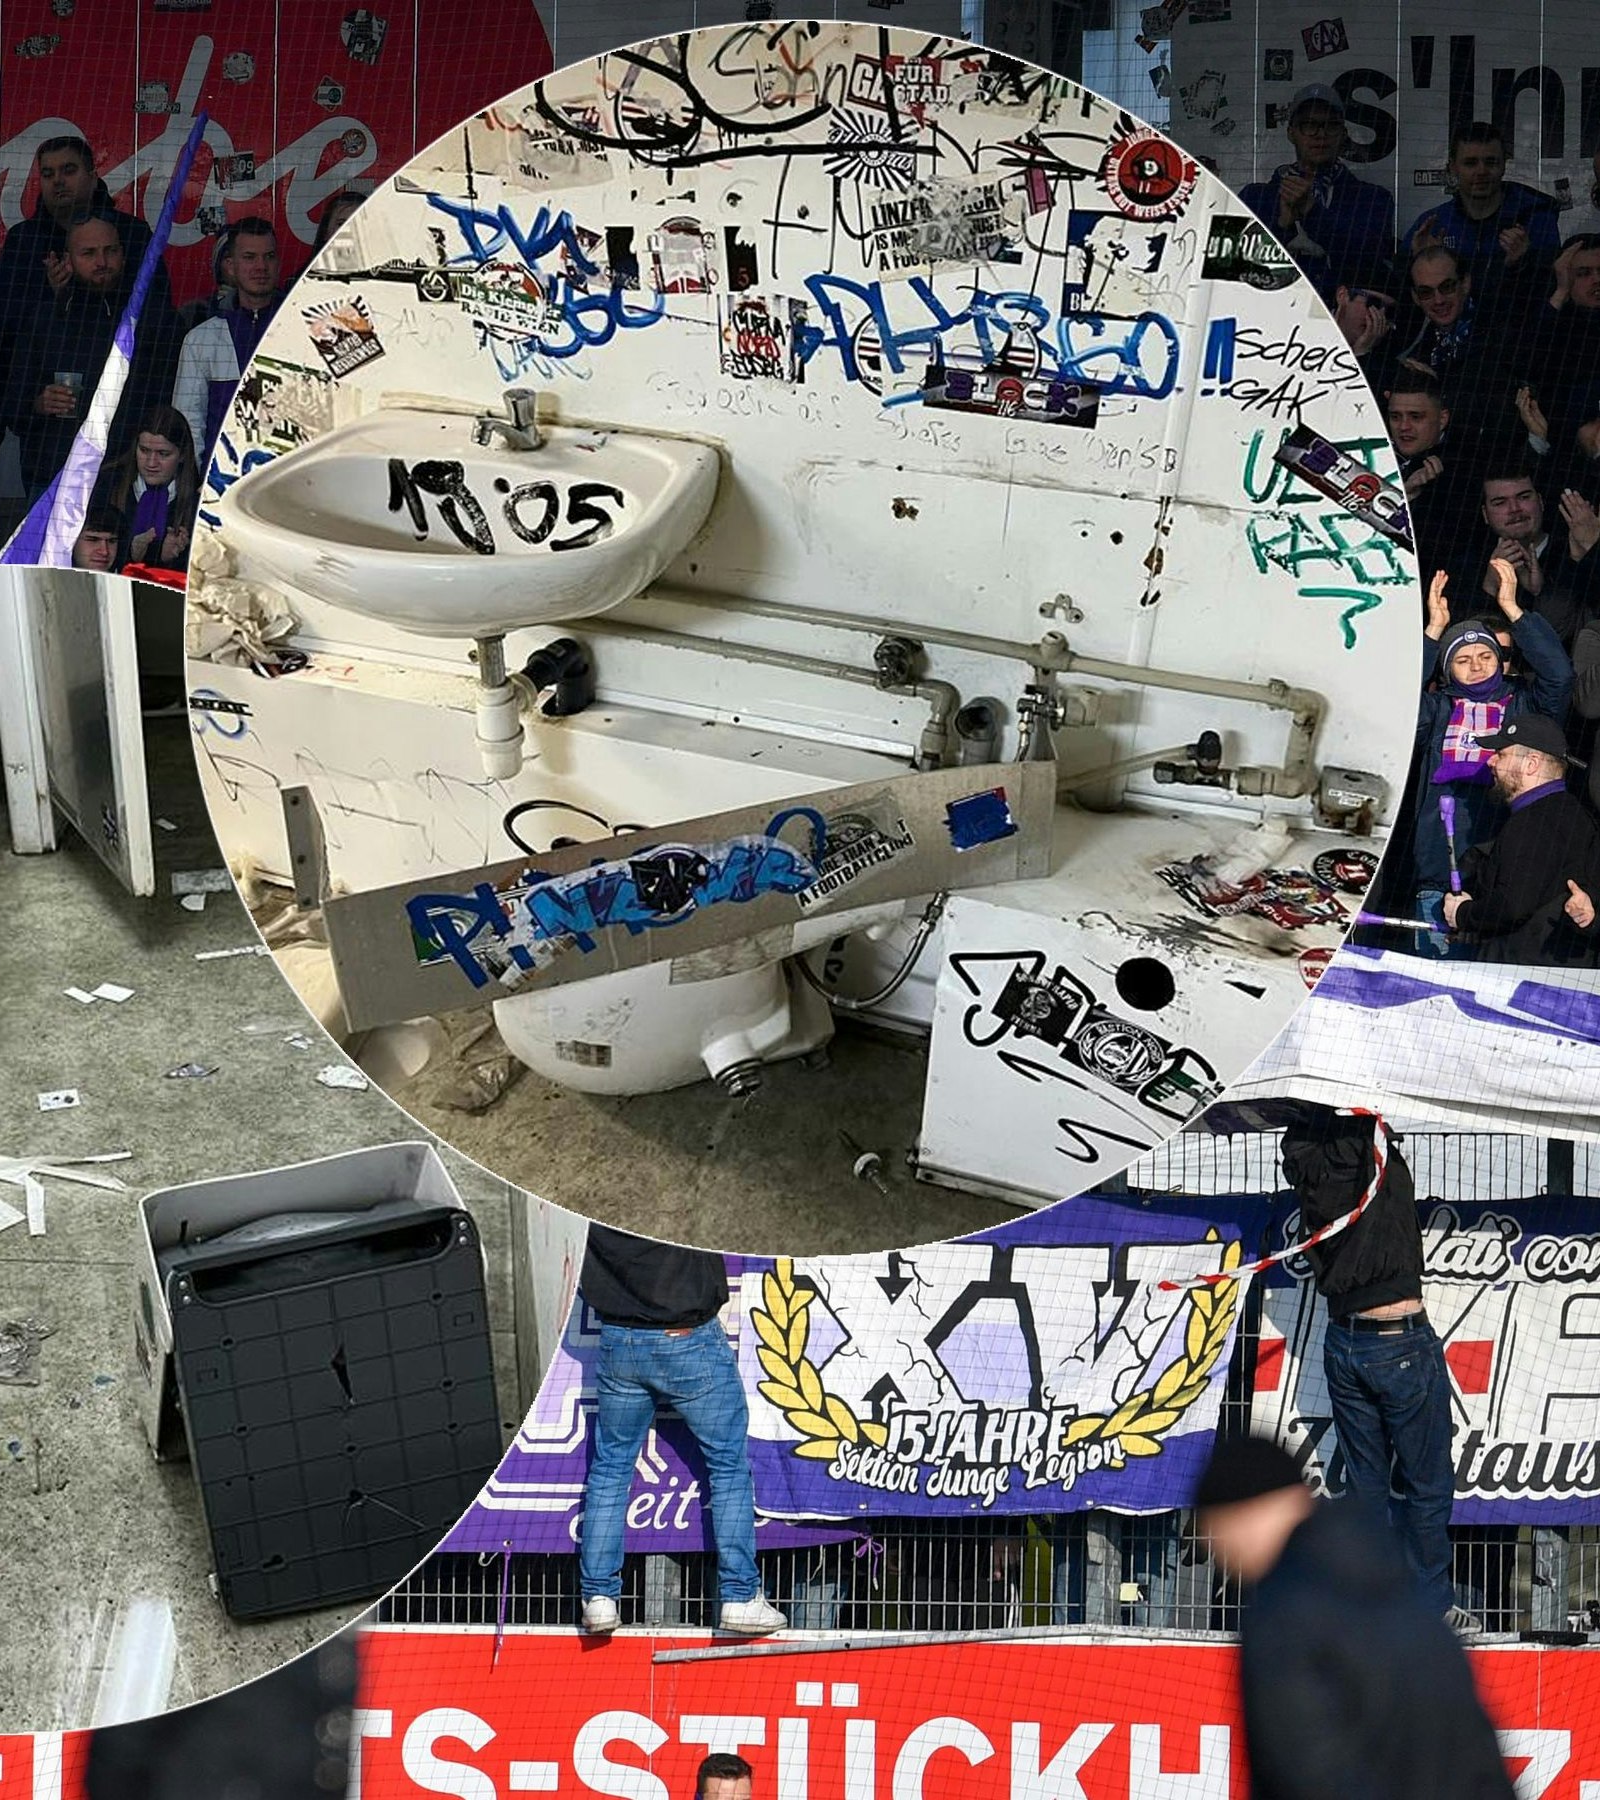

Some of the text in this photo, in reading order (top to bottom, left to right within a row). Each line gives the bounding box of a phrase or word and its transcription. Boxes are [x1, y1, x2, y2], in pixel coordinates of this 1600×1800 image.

[1229, 373, 1329, 423] GAK
[794, 1243, 1226, 1418] XV
[923, 1408, 1078, 1464] JAHRE
[925, 1456, 1010, 1507] Junge
